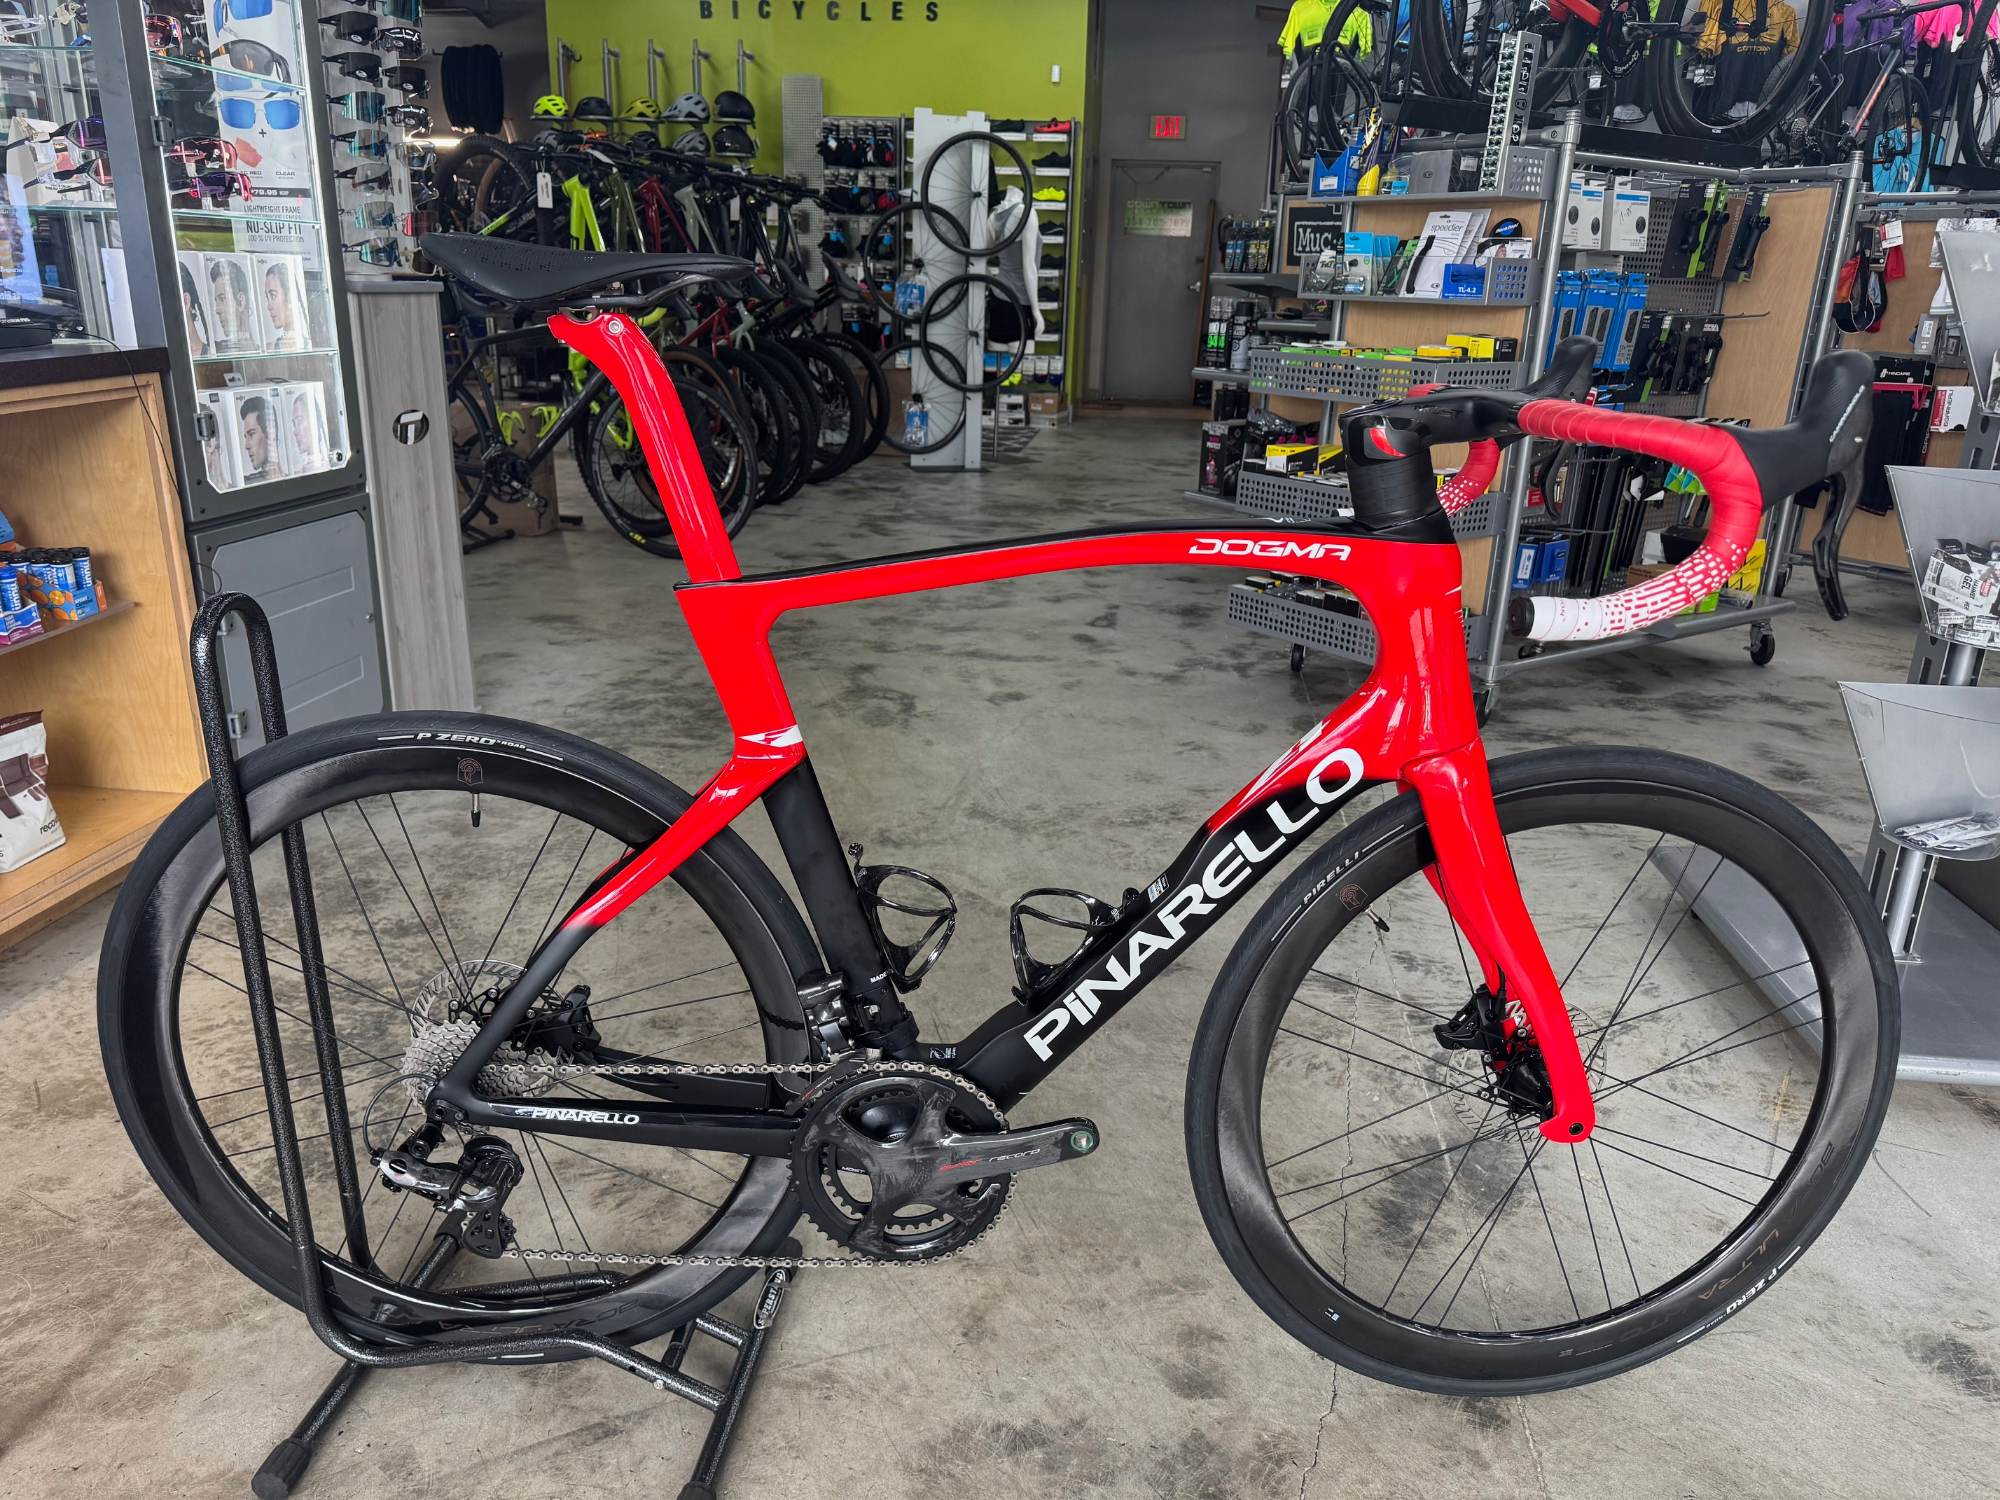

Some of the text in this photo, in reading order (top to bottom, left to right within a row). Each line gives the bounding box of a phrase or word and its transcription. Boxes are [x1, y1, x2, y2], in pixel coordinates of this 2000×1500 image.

[699, 0, 939, 22] BICYCLES
[1155, 115, 1180, 138] EXIT
[1188, 538, 1352, 562] DOGMA
[84, 560, 93, 588] nuun
[1961, 575, 1974, 591] GEL
[11, 582, 21, 611] nuun
[436, 732, 496, 746] ZERO
[1303, 850, 1360, 905] PIRELLI
[1726, 1278, 1766, 1315] ZERO
